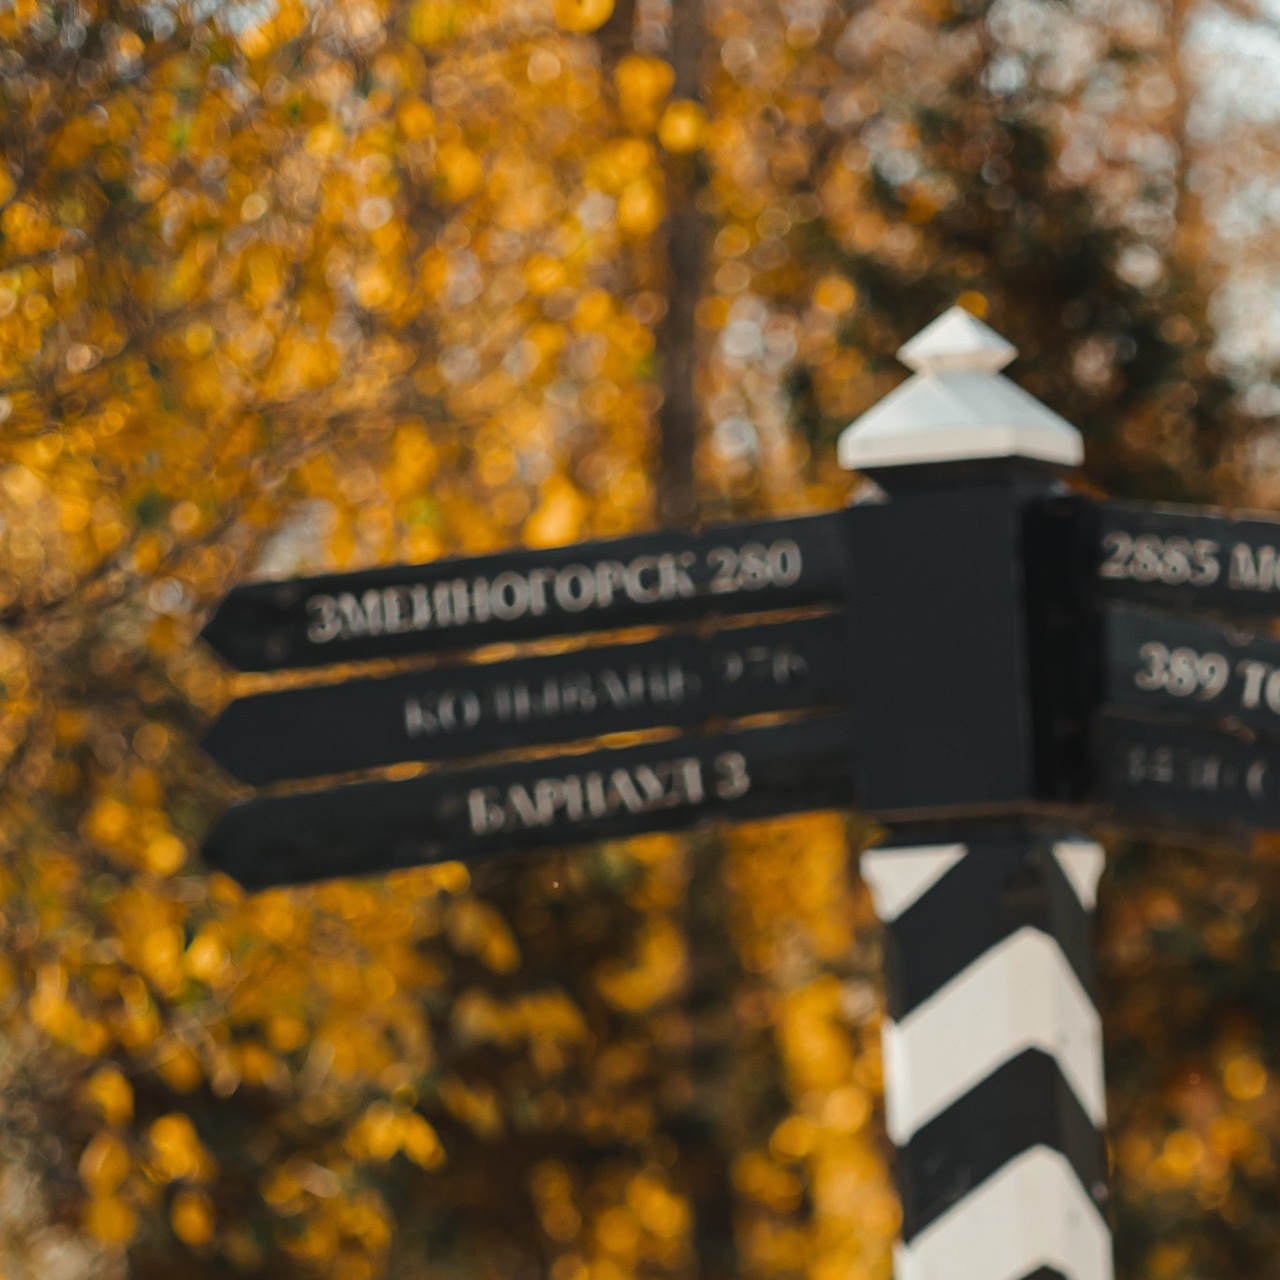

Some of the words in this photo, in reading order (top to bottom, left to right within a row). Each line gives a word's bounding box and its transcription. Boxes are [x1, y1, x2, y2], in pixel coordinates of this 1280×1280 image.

[306, 550, 697, 643] ЗМЕИНОГОРСК
[705, 538, 804, 594] 280
[1101, 531, 1222, 586] 2885
[1133, 639, 1231, 700] 389
[466, 756, 704, 835] БАРНАУЛ
[715, 751, 752, 797] 3
